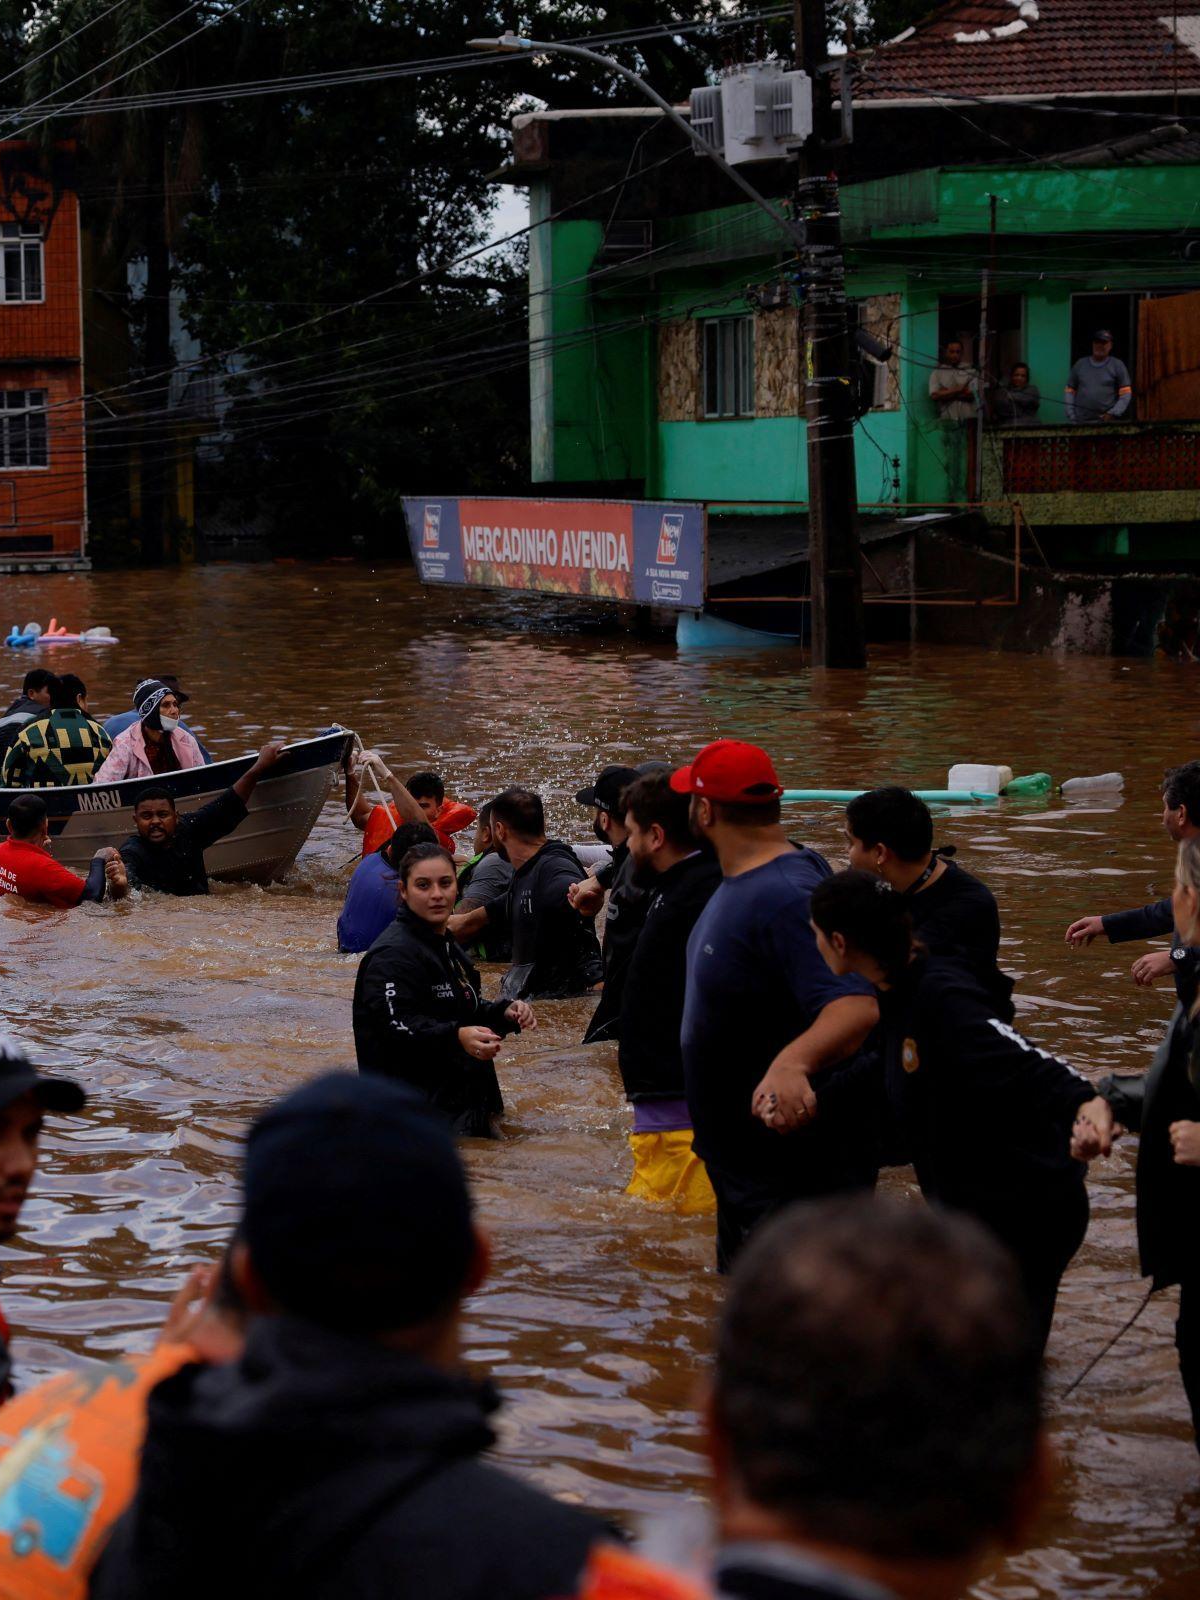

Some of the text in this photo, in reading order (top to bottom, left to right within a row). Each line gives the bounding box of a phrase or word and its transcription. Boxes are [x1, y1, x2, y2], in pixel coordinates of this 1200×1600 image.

[663, 521, 681, 538] New
[462, 525, 630, 572] MERCADINHO AVENIDA
[661, 538, 677, 557] Life
[77, 789, 122, 812] MARU
[7, 871, 17, 882] DE
